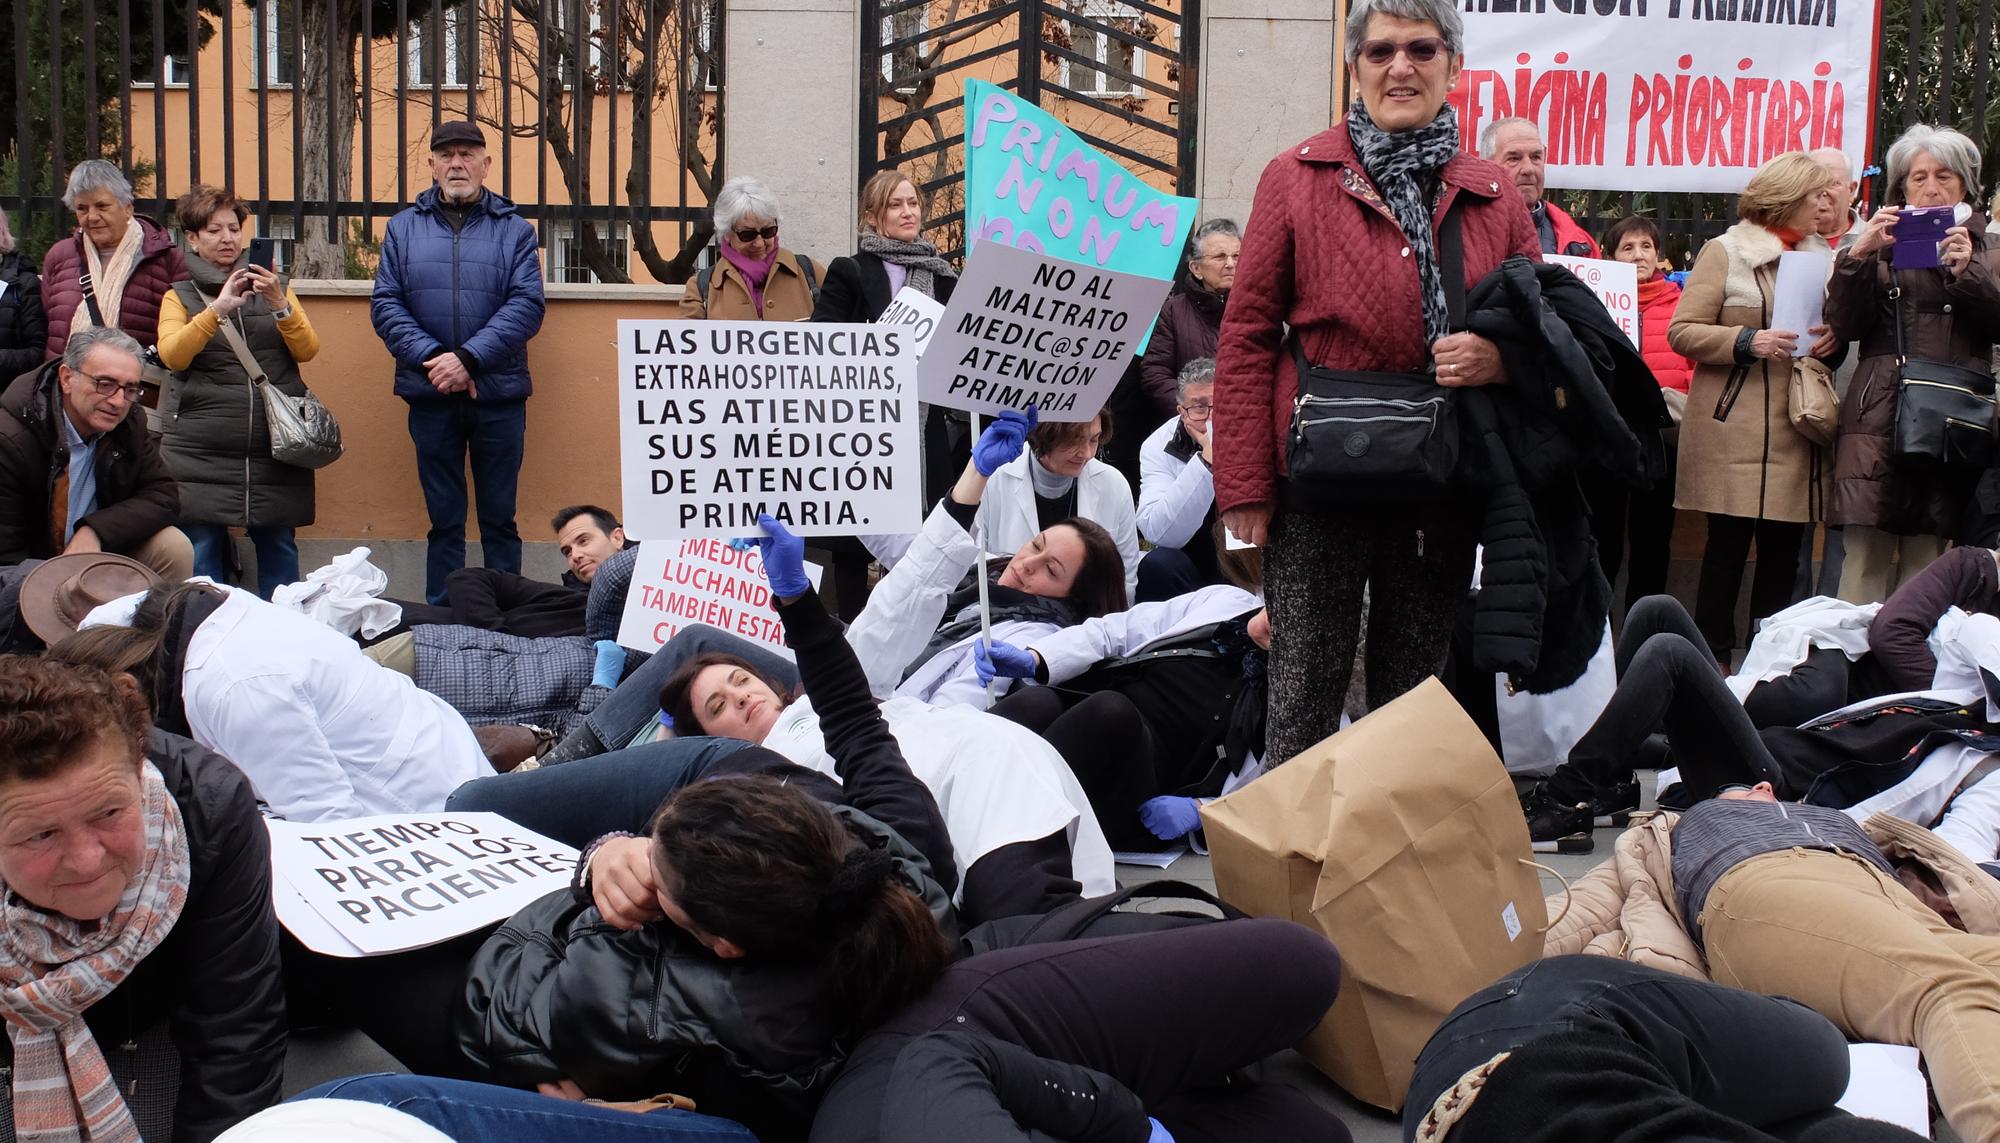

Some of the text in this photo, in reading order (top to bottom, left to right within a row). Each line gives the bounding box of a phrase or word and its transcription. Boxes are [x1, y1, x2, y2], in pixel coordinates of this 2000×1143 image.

[995, 156, 1121, 266] NON
[1033, 263, 1113, 301] NO AL
[1606, 291, 1631, 311] NO
[985, 286, 1129, 333] MALTRATO
[634, 329, 901, 357] LAS URGENCIAS
[956, 313, 1126, 361] MEDIC@S DE
[635, 364, 902, 393] EXTRAHOSPITALARIAS,
[960, 346, 1097, 386] ATENCIÓN
[638, 398, 901, 425] LAS ATIENDEN
[948, 374, 1078, 412] PRIMARIA
[648, 428, 894, 460] SUS MÉDICOS
[651, 461, 893, 495] DE ATENCIÓN
[679, 500, 870, 529] PRIMARIA.
[642, 585, 732, 629] TAMBIÉN
[301, 820, 479, 860] TIEMPO
[315, 836, 538, 892] PARA LOS
[337, 852, 578, 924] PACIENTES
